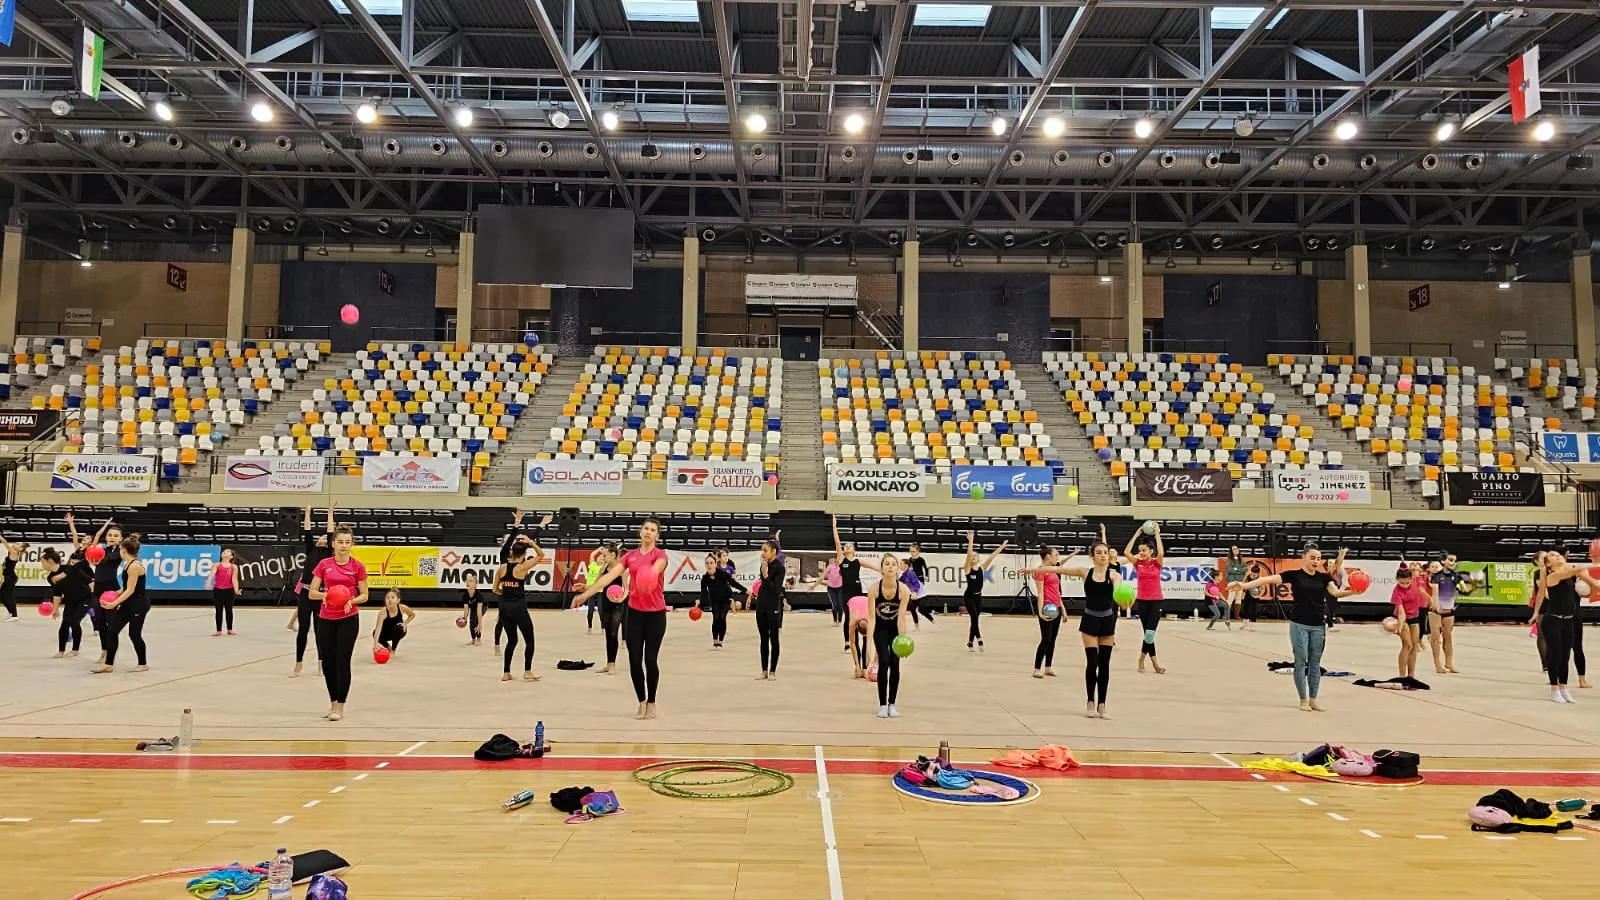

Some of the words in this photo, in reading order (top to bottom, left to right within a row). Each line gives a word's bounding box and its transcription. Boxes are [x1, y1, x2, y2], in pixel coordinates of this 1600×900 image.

[170, 268, 180, 284] 12
[1417, 288, 1428, 305] 18
[543, 471, 621, 481] SOLANO
[712, 467, 754, 475] TRANSPORTES
[845, 469, 917, 479] AZULEJOS
[712, 475, 761, 488] CALLIZO
[837, 480, 920, 492] MONCAYO
[1153, 474, 1173, 494] El
[1172, 474, 1214, 494] Criollo
[440, 568, 551, 587] MONYO
